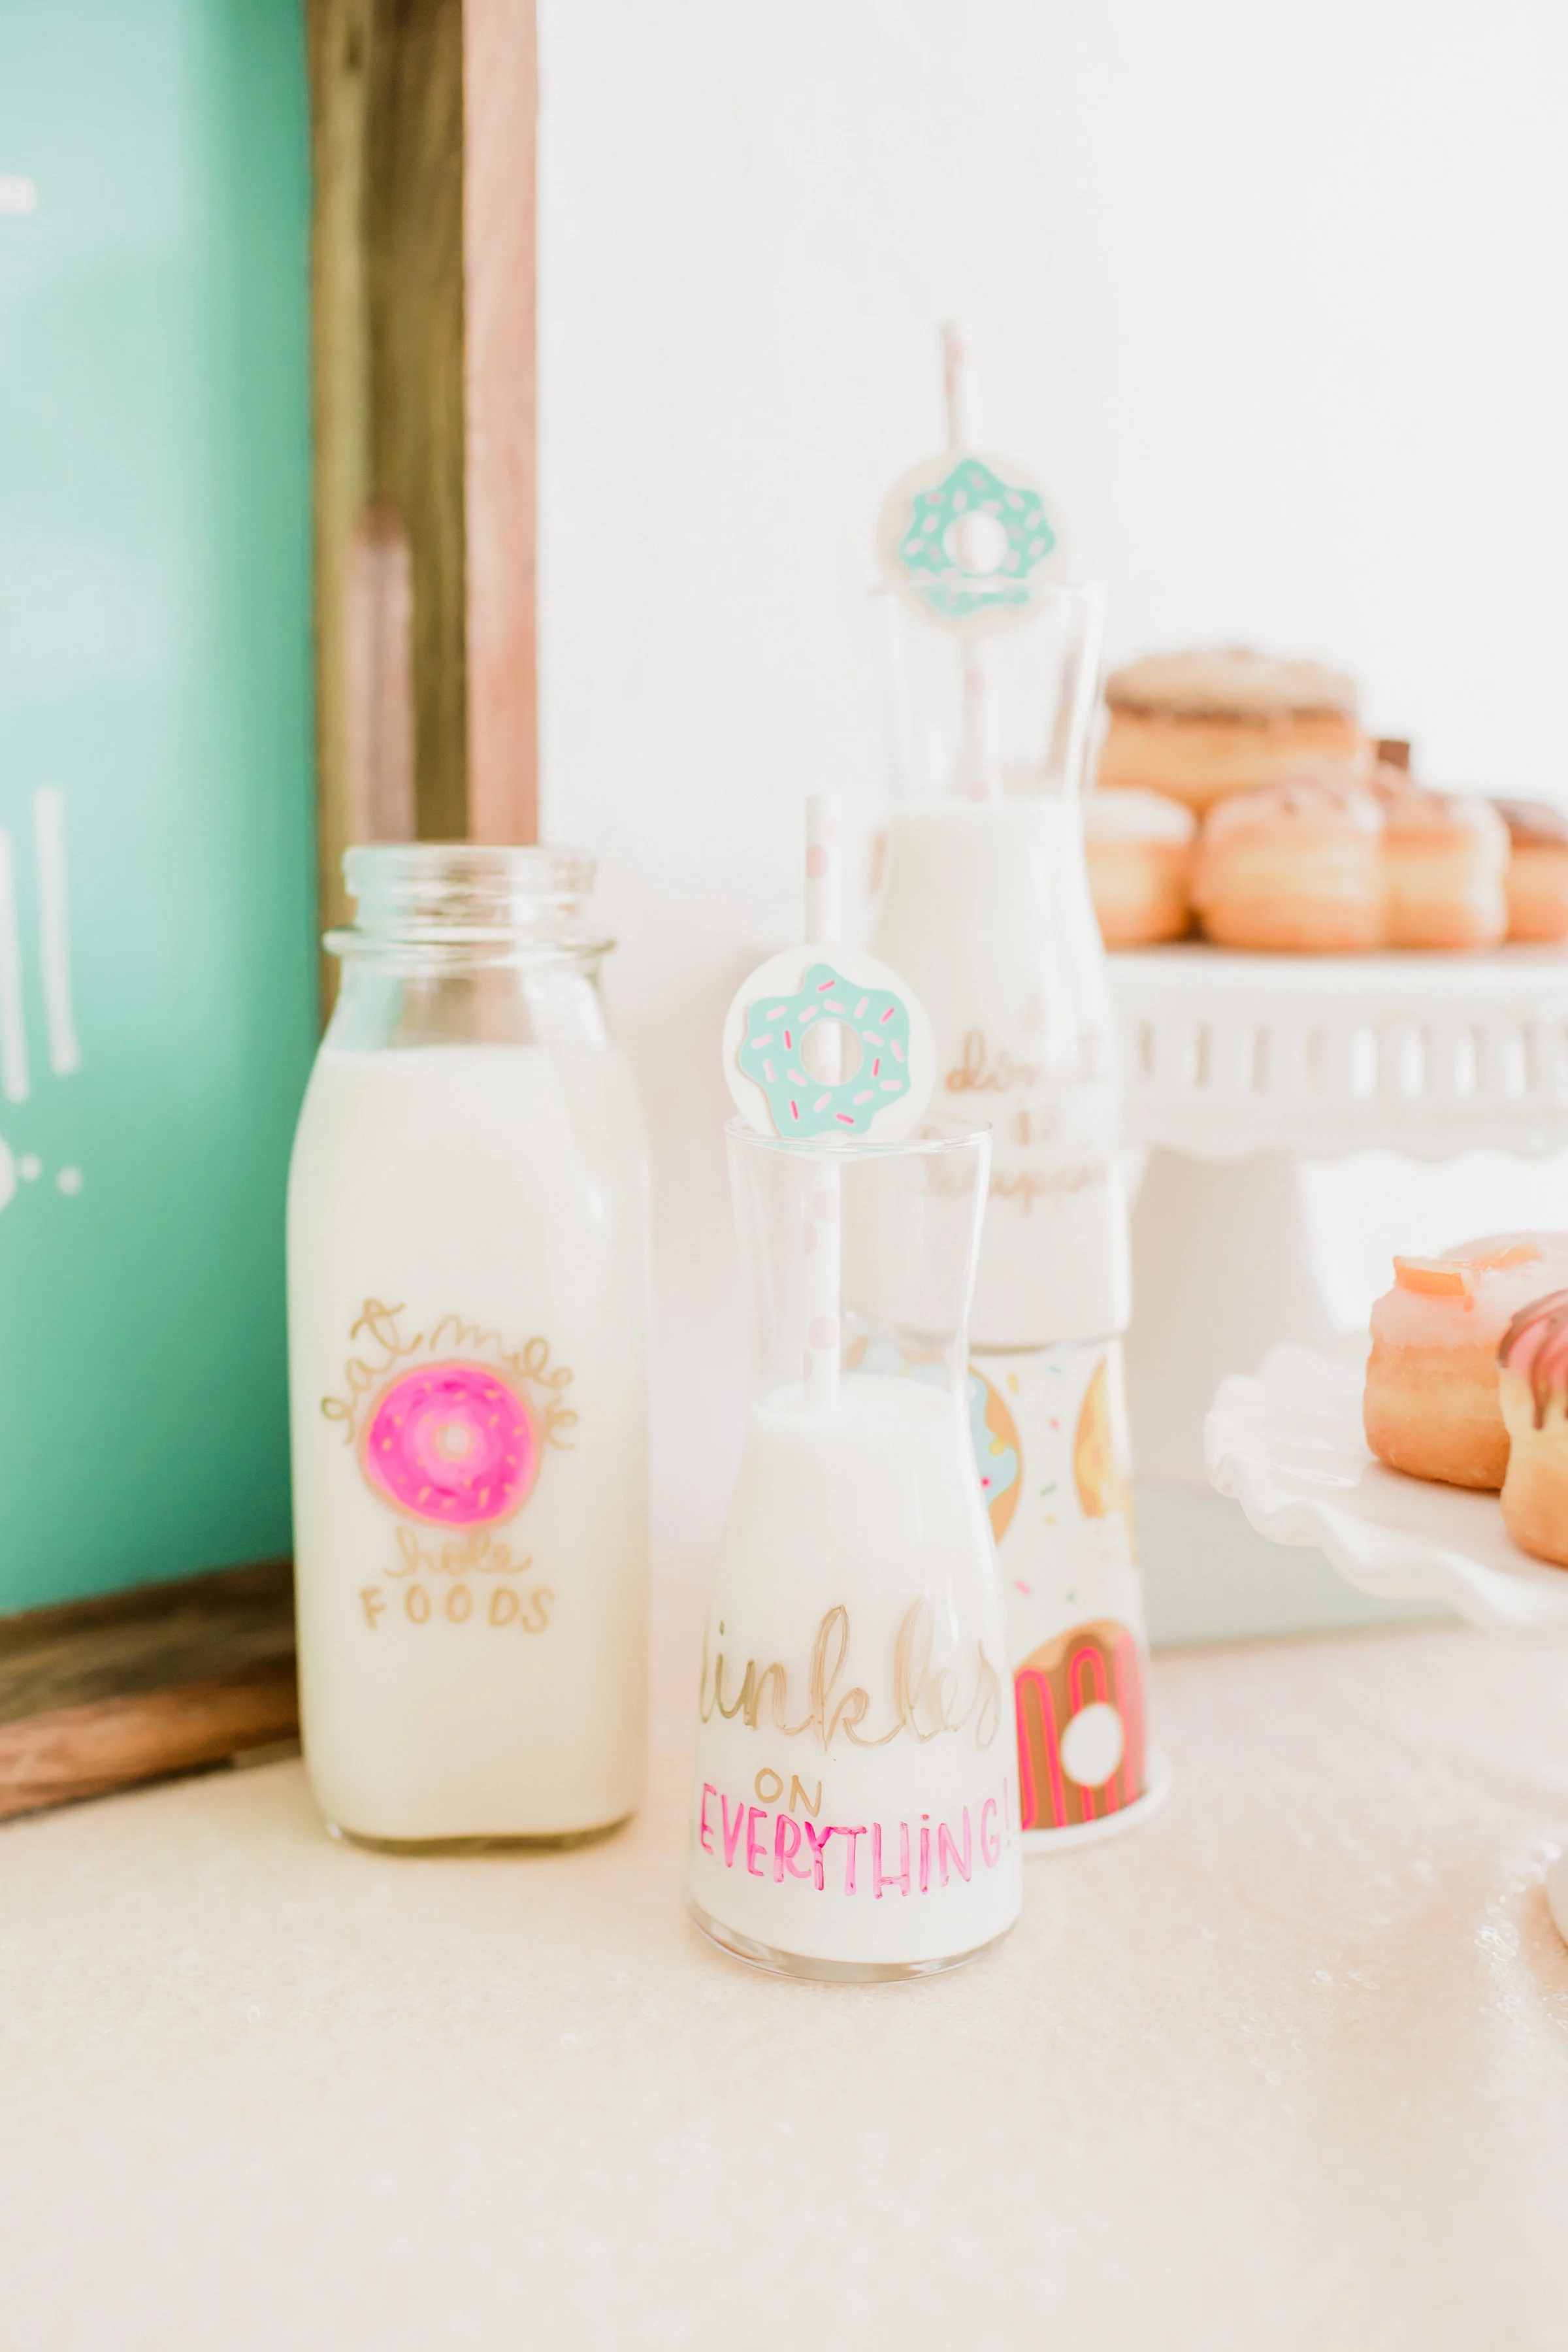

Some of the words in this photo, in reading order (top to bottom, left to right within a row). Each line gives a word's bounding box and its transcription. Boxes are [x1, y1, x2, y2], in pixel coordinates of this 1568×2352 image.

[382, 1525, 534, 1580] hole
[359, 1583, 556, 1634] FOODS
[698, 1598, 1002, 1754] inkles
[754, 1767, 823, 1818] ON
